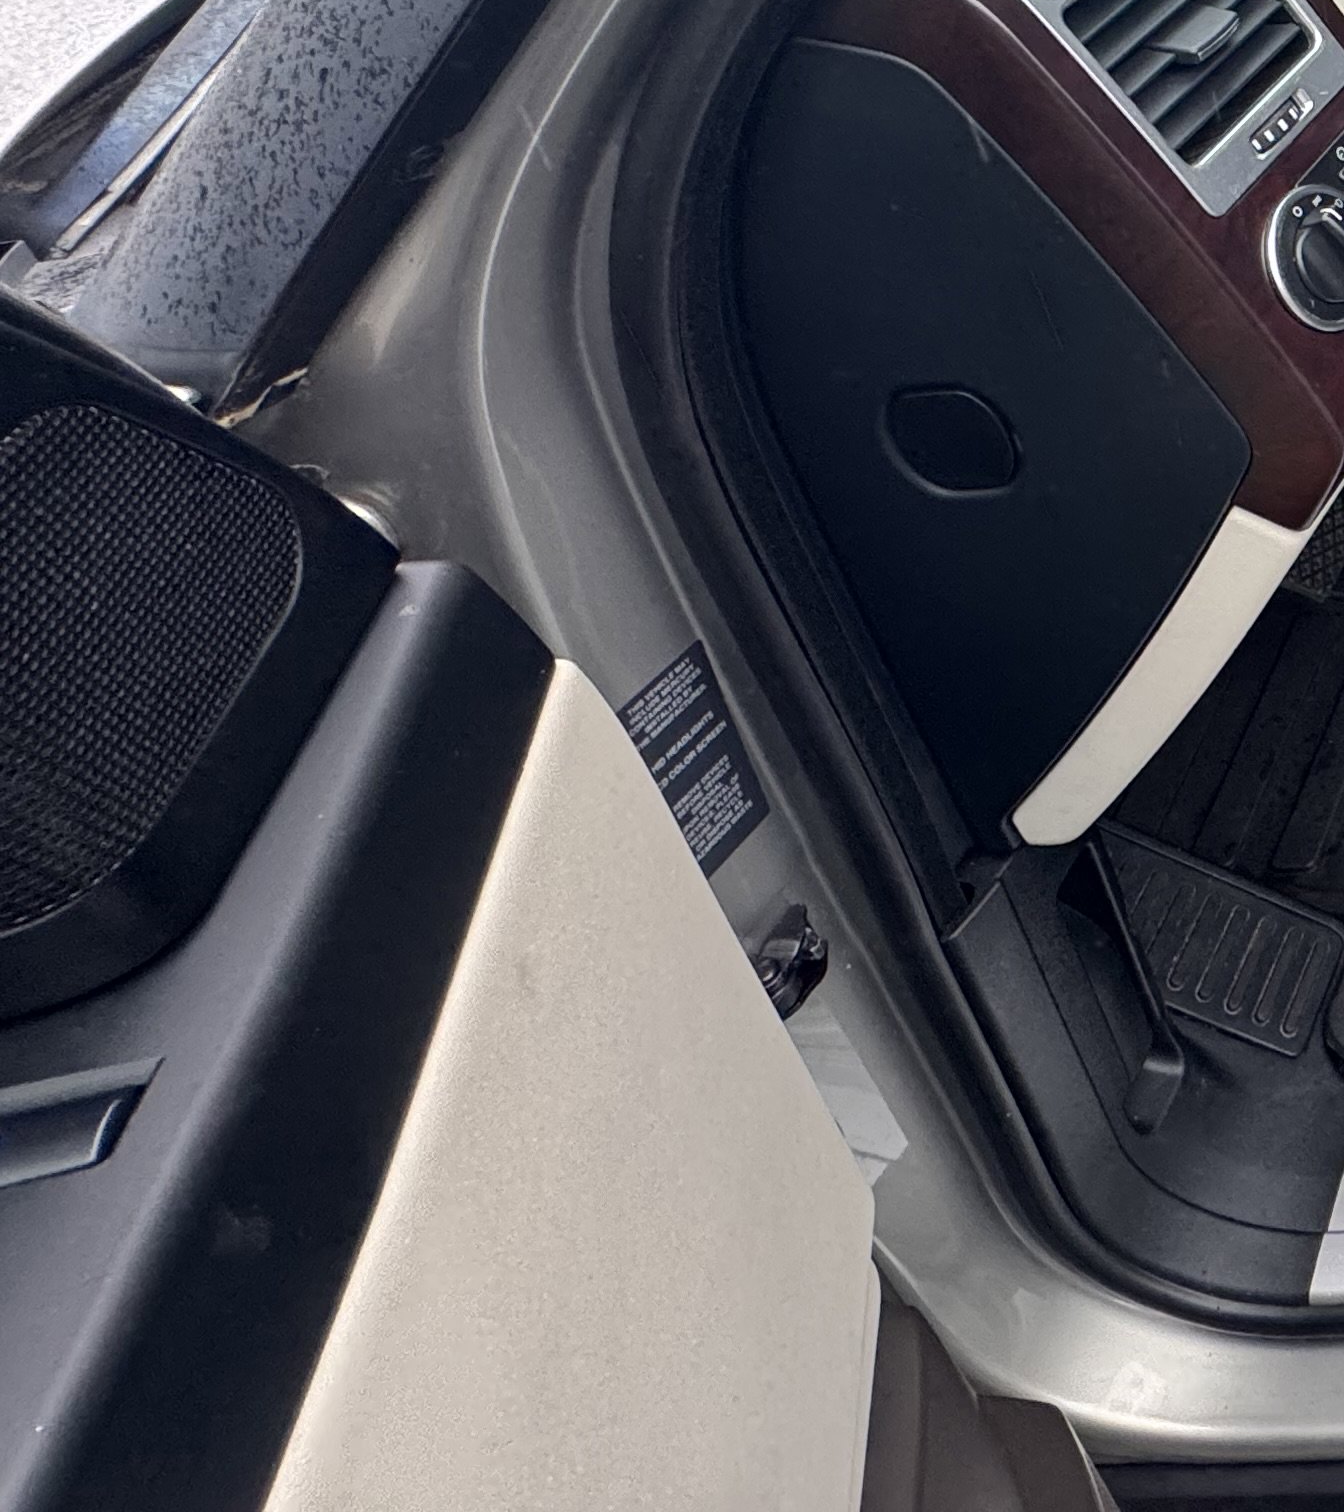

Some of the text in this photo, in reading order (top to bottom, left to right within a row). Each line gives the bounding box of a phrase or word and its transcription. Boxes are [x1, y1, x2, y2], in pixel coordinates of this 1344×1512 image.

[644, 671, 674, 701] VEHICLE
[674, 656, 690, 674] MAY
[664, 708, 714, 760] HEADLIGHTS
[667, 748, 696, 780] COLOR
[695, 718, 726, 753] SCREEN
